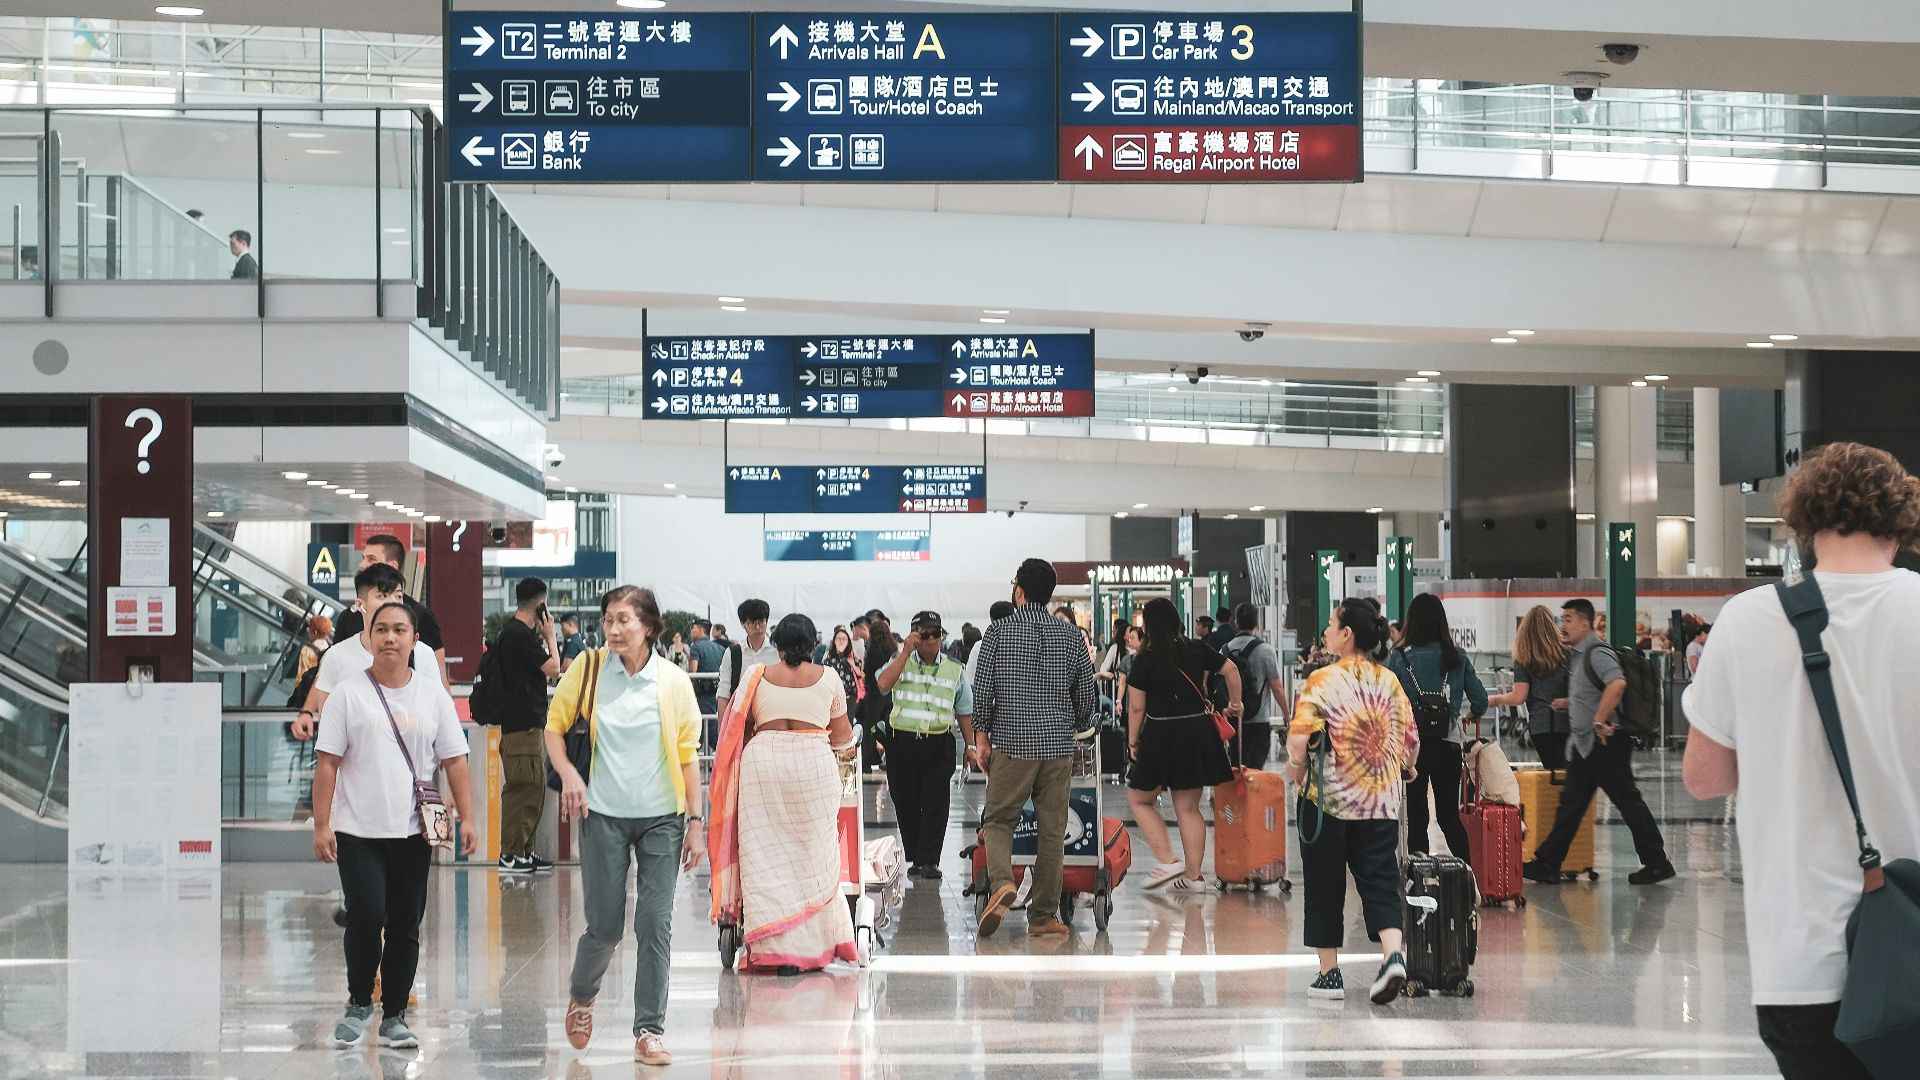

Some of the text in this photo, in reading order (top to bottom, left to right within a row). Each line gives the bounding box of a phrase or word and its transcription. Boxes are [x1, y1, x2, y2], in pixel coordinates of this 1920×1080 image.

[543, 20, 691, 43] 二號客運大樓
[808, 20, 905, 44] 接機大堂
[1153, 21, 1224, 43] 停車場
[506, 31, 533, 51] T2
[913, 24, 945, 59] A
[1118, 29, 1141, 57] P
[1231, 25, 1254, 60] 3
[544, 44, 626, 60] Terminal 2
[809, 44, 903, 60] Arrivals Hall
[1152, 44, 1217, 60] Car Park
[587, 76, 660, 99] 往市區
[849, 75, 998, 98] 團隊/酒店巴士
[586, 101, 638, 119] To city
[849, 99, 982, 115] Tour/Hotel Coach
[1154, 100, 1353, 118] Mainland/Macao Transport
[544, 130, 590, 153] 銀行
[1154, 130, 1299, 153] 富豪機場酒店
[543, 154, 581, 169] Bank
[1154, 155, 1299, 173] Regal Airport Hotel
[674, 345, 686, 356] T1
[726, 352, 749, 360] Aisles
[823, 344, 836, 355] T2
[877, 351, 882, 359] 2
[971, 350, 1017, 358] Arrivals Hall
[1022, 339, 1038, 357] A
[691, 379, 724, 387] Car Park
[730, 368, 743, 386] 4
[862, 378, 887, 388] To city
[991, 377, 1056, 385] Tour/Hotel Coach
[692, 406, 790, 415] Mainland/Macao Transport
[991, 404, 1063, 413] Regal Airport Hotel
[312, 547, 336, 575] A
